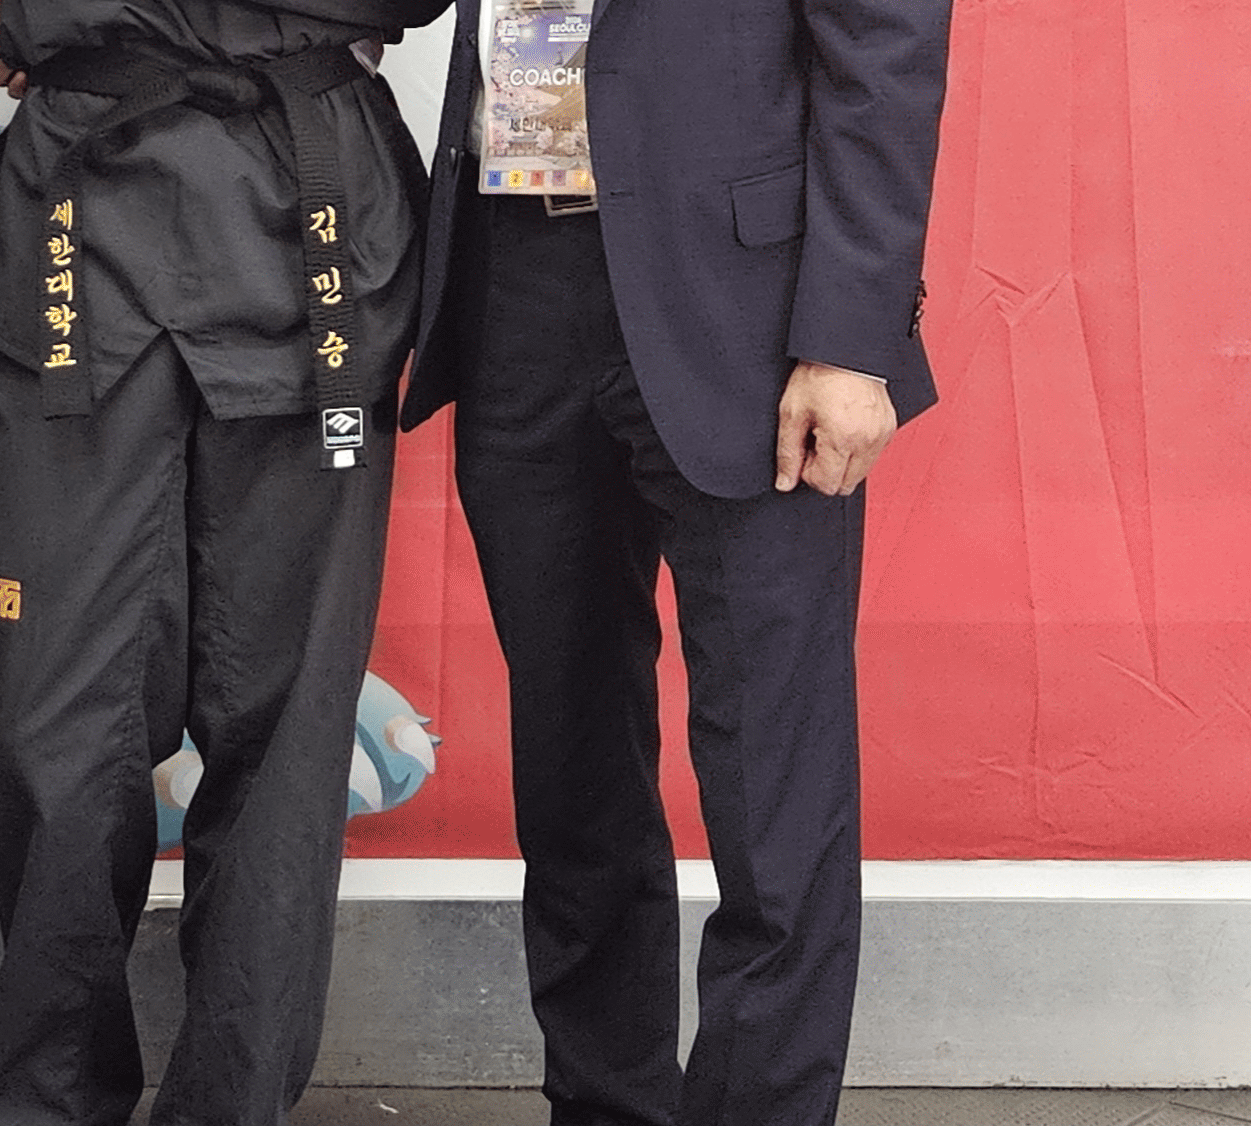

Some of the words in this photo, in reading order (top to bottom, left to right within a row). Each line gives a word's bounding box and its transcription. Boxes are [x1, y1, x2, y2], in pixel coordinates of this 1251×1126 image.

[509, 67, 582, 86] COACH
[44, 199, 77, 368] 세한대학교
[309, 205, 349, 368] 김민승
